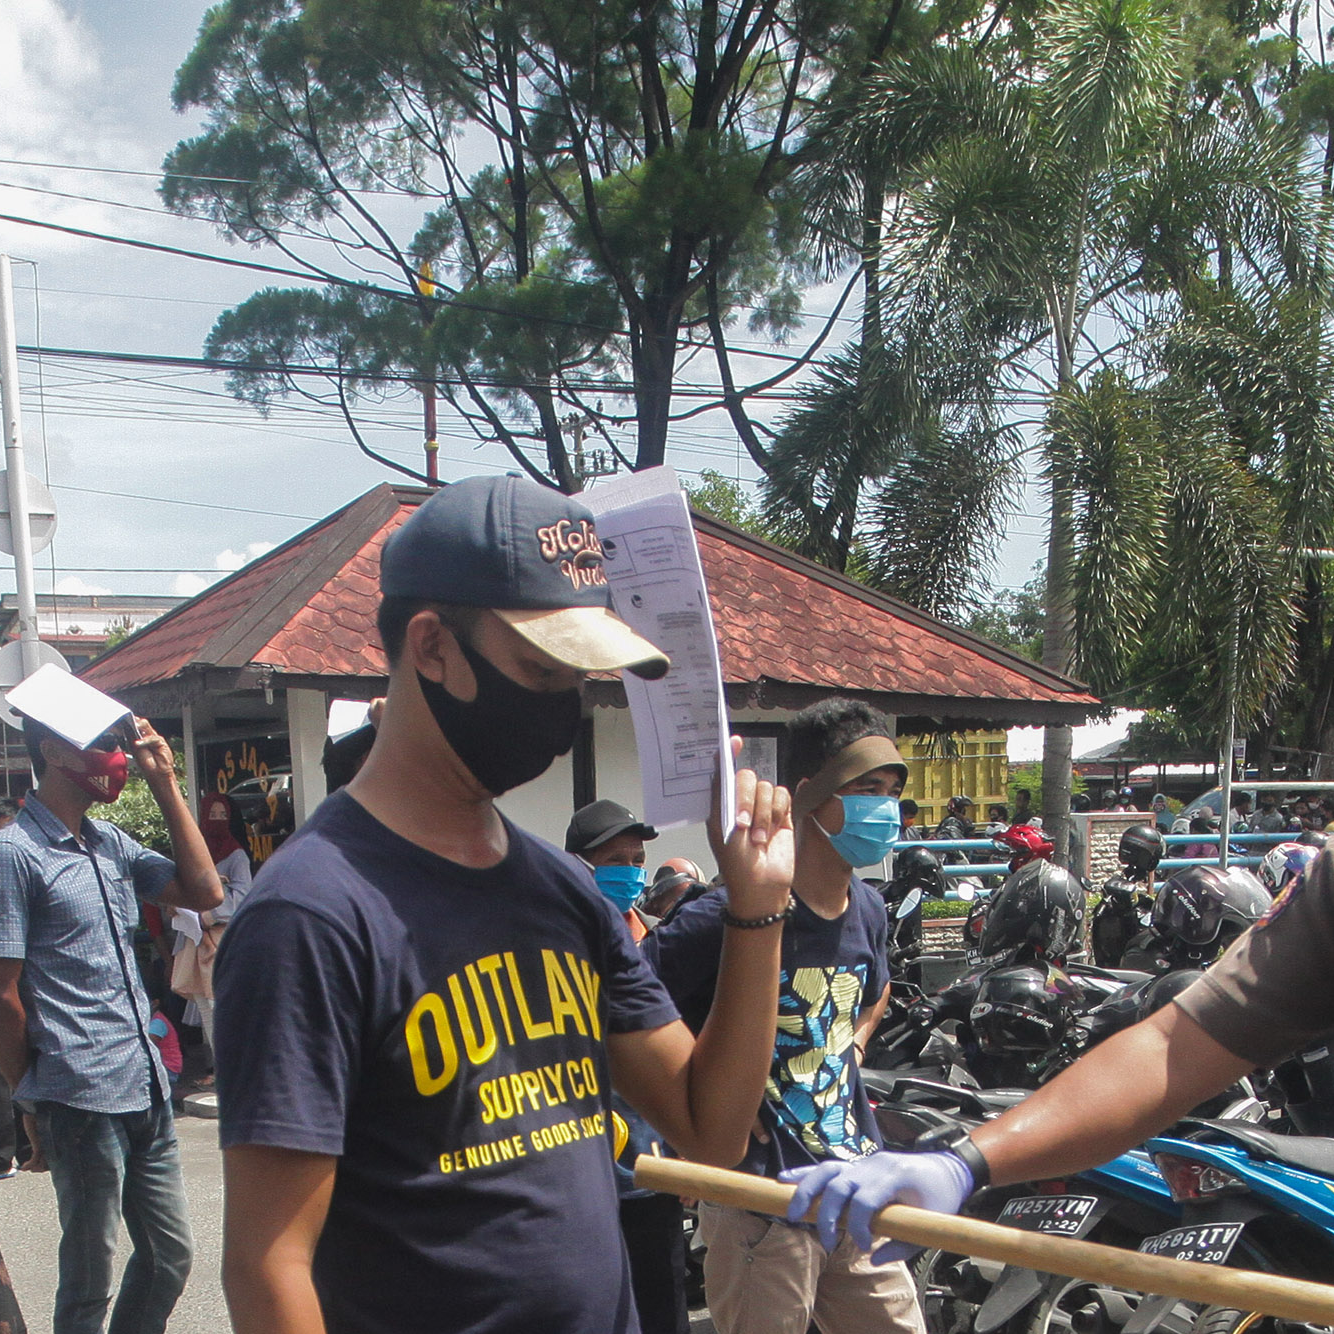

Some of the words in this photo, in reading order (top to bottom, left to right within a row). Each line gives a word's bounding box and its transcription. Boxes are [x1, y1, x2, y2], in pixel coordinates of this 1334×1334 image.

[405, 949, 600, 1096] OUTLAW
[479, 1063, 567, 1124] SUPPLY
[566, 1057, 599, 1099] CO
[439, 1135, 527, 1174] GENUINE
[531, 1119, 580, 1152] GOODS
[580, 1110, 606, 1139] SINC
